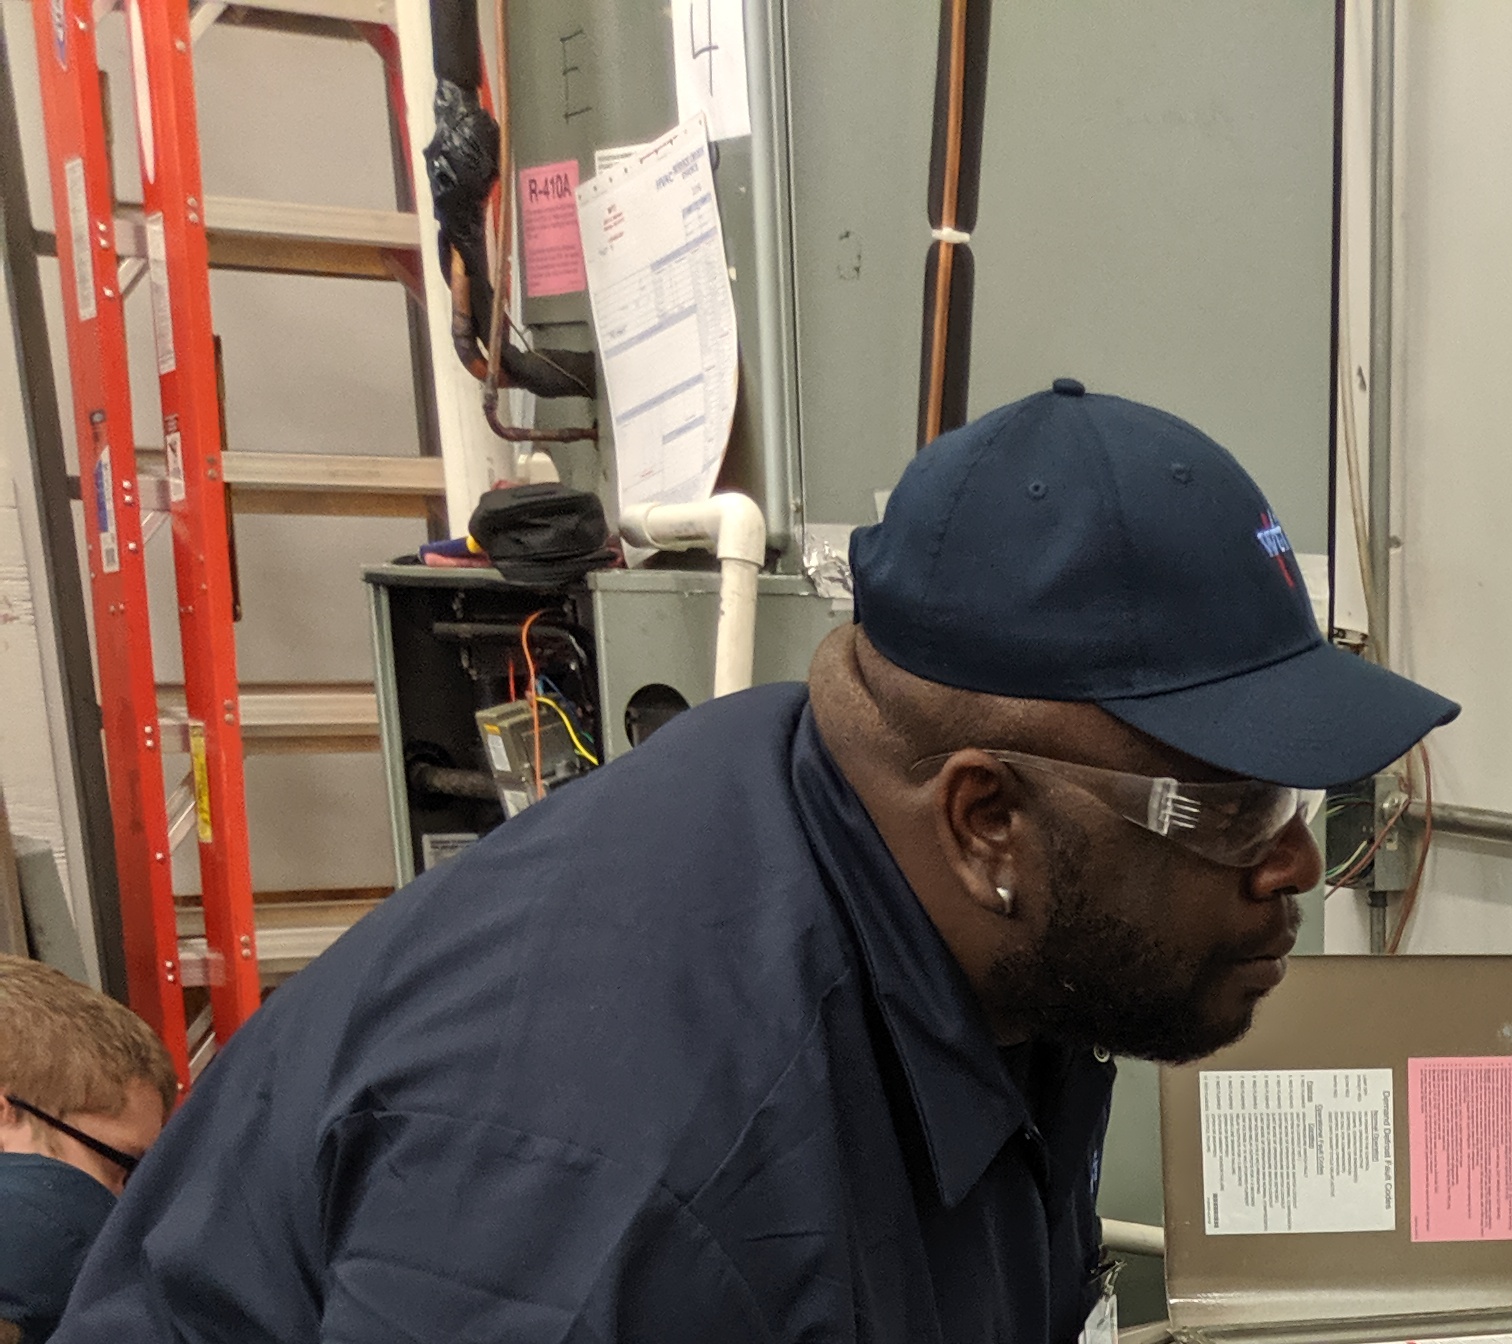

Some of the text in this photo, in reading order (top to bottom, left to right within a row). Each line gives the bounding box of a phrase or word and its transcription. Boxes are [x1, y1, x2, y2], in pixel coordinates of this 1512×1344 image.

[528, 174, 574, 203] R-410A
[1382, 1090, 1392, 1210] Demand Defrost Fault Codes
